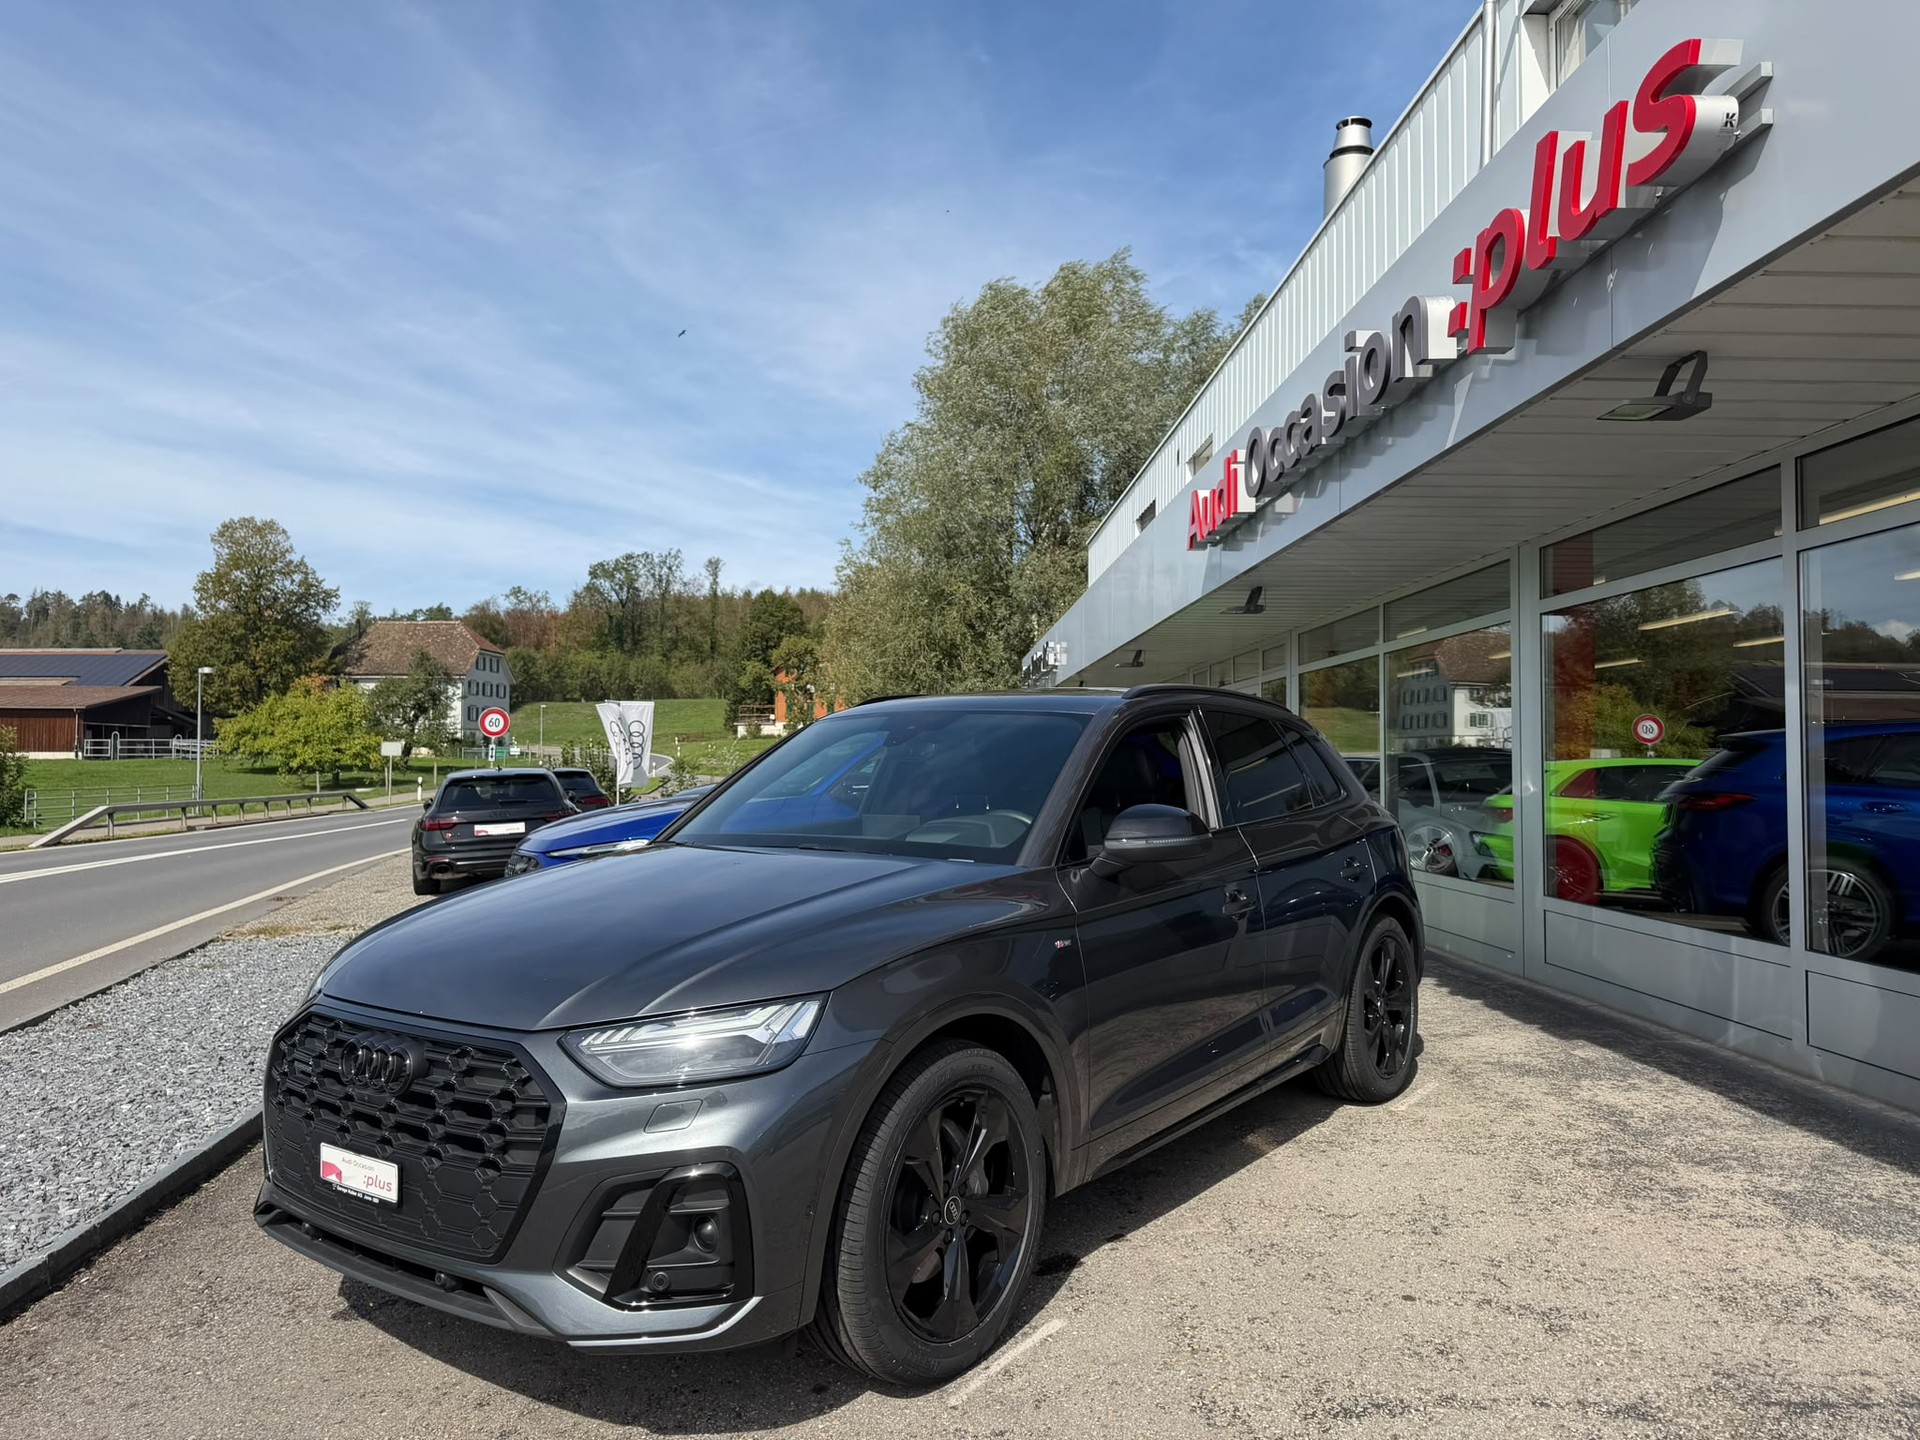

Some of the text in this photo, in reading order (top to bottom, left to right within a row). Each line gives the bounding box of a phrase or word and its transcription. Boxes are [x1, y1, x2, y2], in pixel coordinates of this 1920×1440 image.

[1187, 38, 1702, 550] Audi Occasion :plus
[488, 717, 501, 728] 60
[353, 1160, 374, 1171] Occasion
[363, 1175, 392, 1192] :plus
